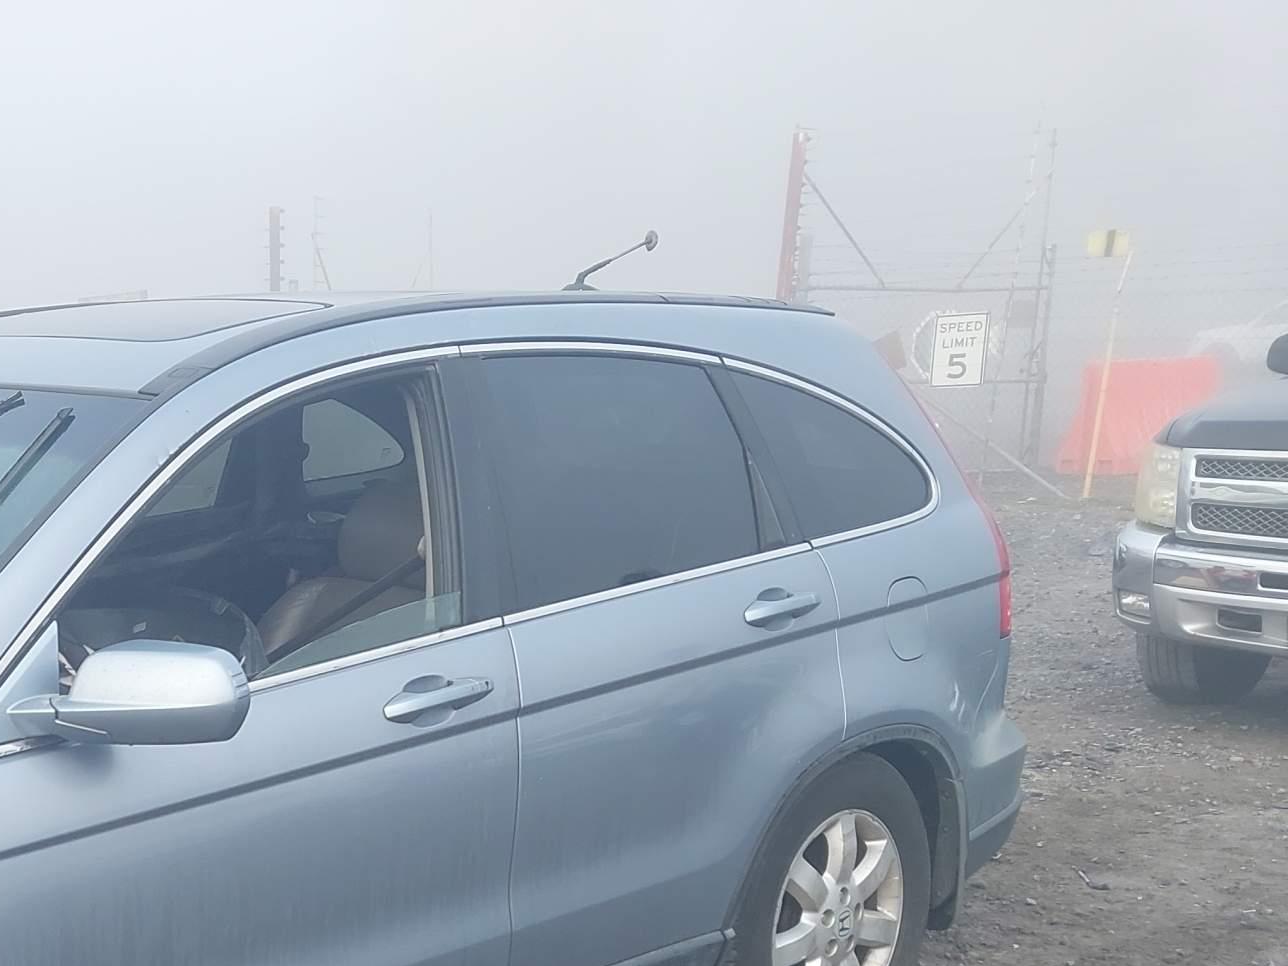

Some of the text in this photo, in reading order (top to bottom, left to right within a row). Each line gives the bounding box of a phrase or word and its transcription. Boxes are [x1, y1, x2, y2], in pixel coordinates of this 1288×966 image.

[939, 320, 983, 334] SPEED
[942, 336, 977, 349] LIMIT
[946, 353, 967, 379] 5
